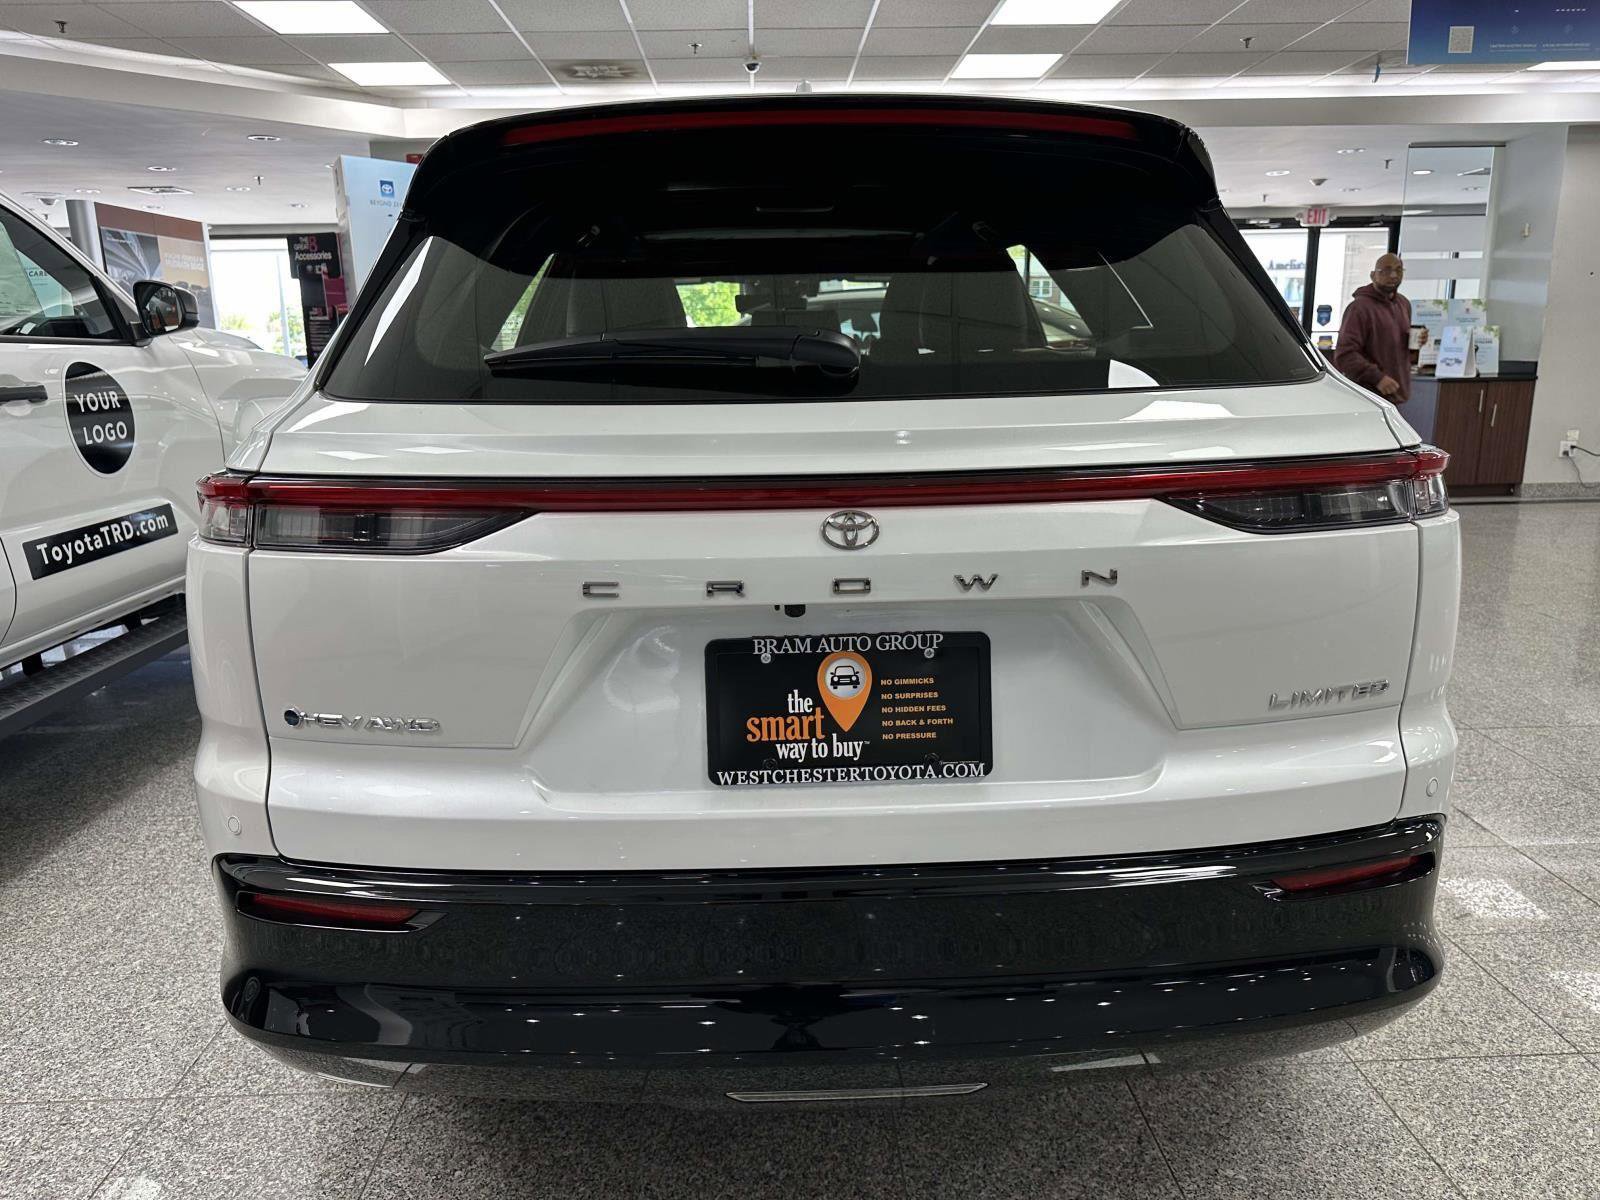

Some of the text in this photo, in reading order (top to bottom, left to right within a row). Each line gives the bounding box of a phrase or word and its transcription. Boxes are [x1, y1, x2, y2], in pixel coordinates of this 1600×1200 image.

[1307, 207, 1327, 224] EXIT
[294, 251, 333, 261] Accessories
[74, 391, 121, 412] YOUR
[83, 421, 128, 445] LOGO
[36, 513, 169, 565] ToyotaTRD.com
[582, 567, 1119, 599] CROWN
[753, 633, 944, 655] BRAM AUTO GROUP
[894, 677, 935, 685] GIMMICKS
[787, 689, 813, 714] the
[895, 691, 939, 699] SURPRISES
[1268, 680, 1390, 709] LIMITED
[746, 707, 826, 742] smart
[776, 741, 808, 763] way
[811, 738, 829, 758] to
[716, 762, 986, 786] WESTCHESTERTOYOTA.COM
